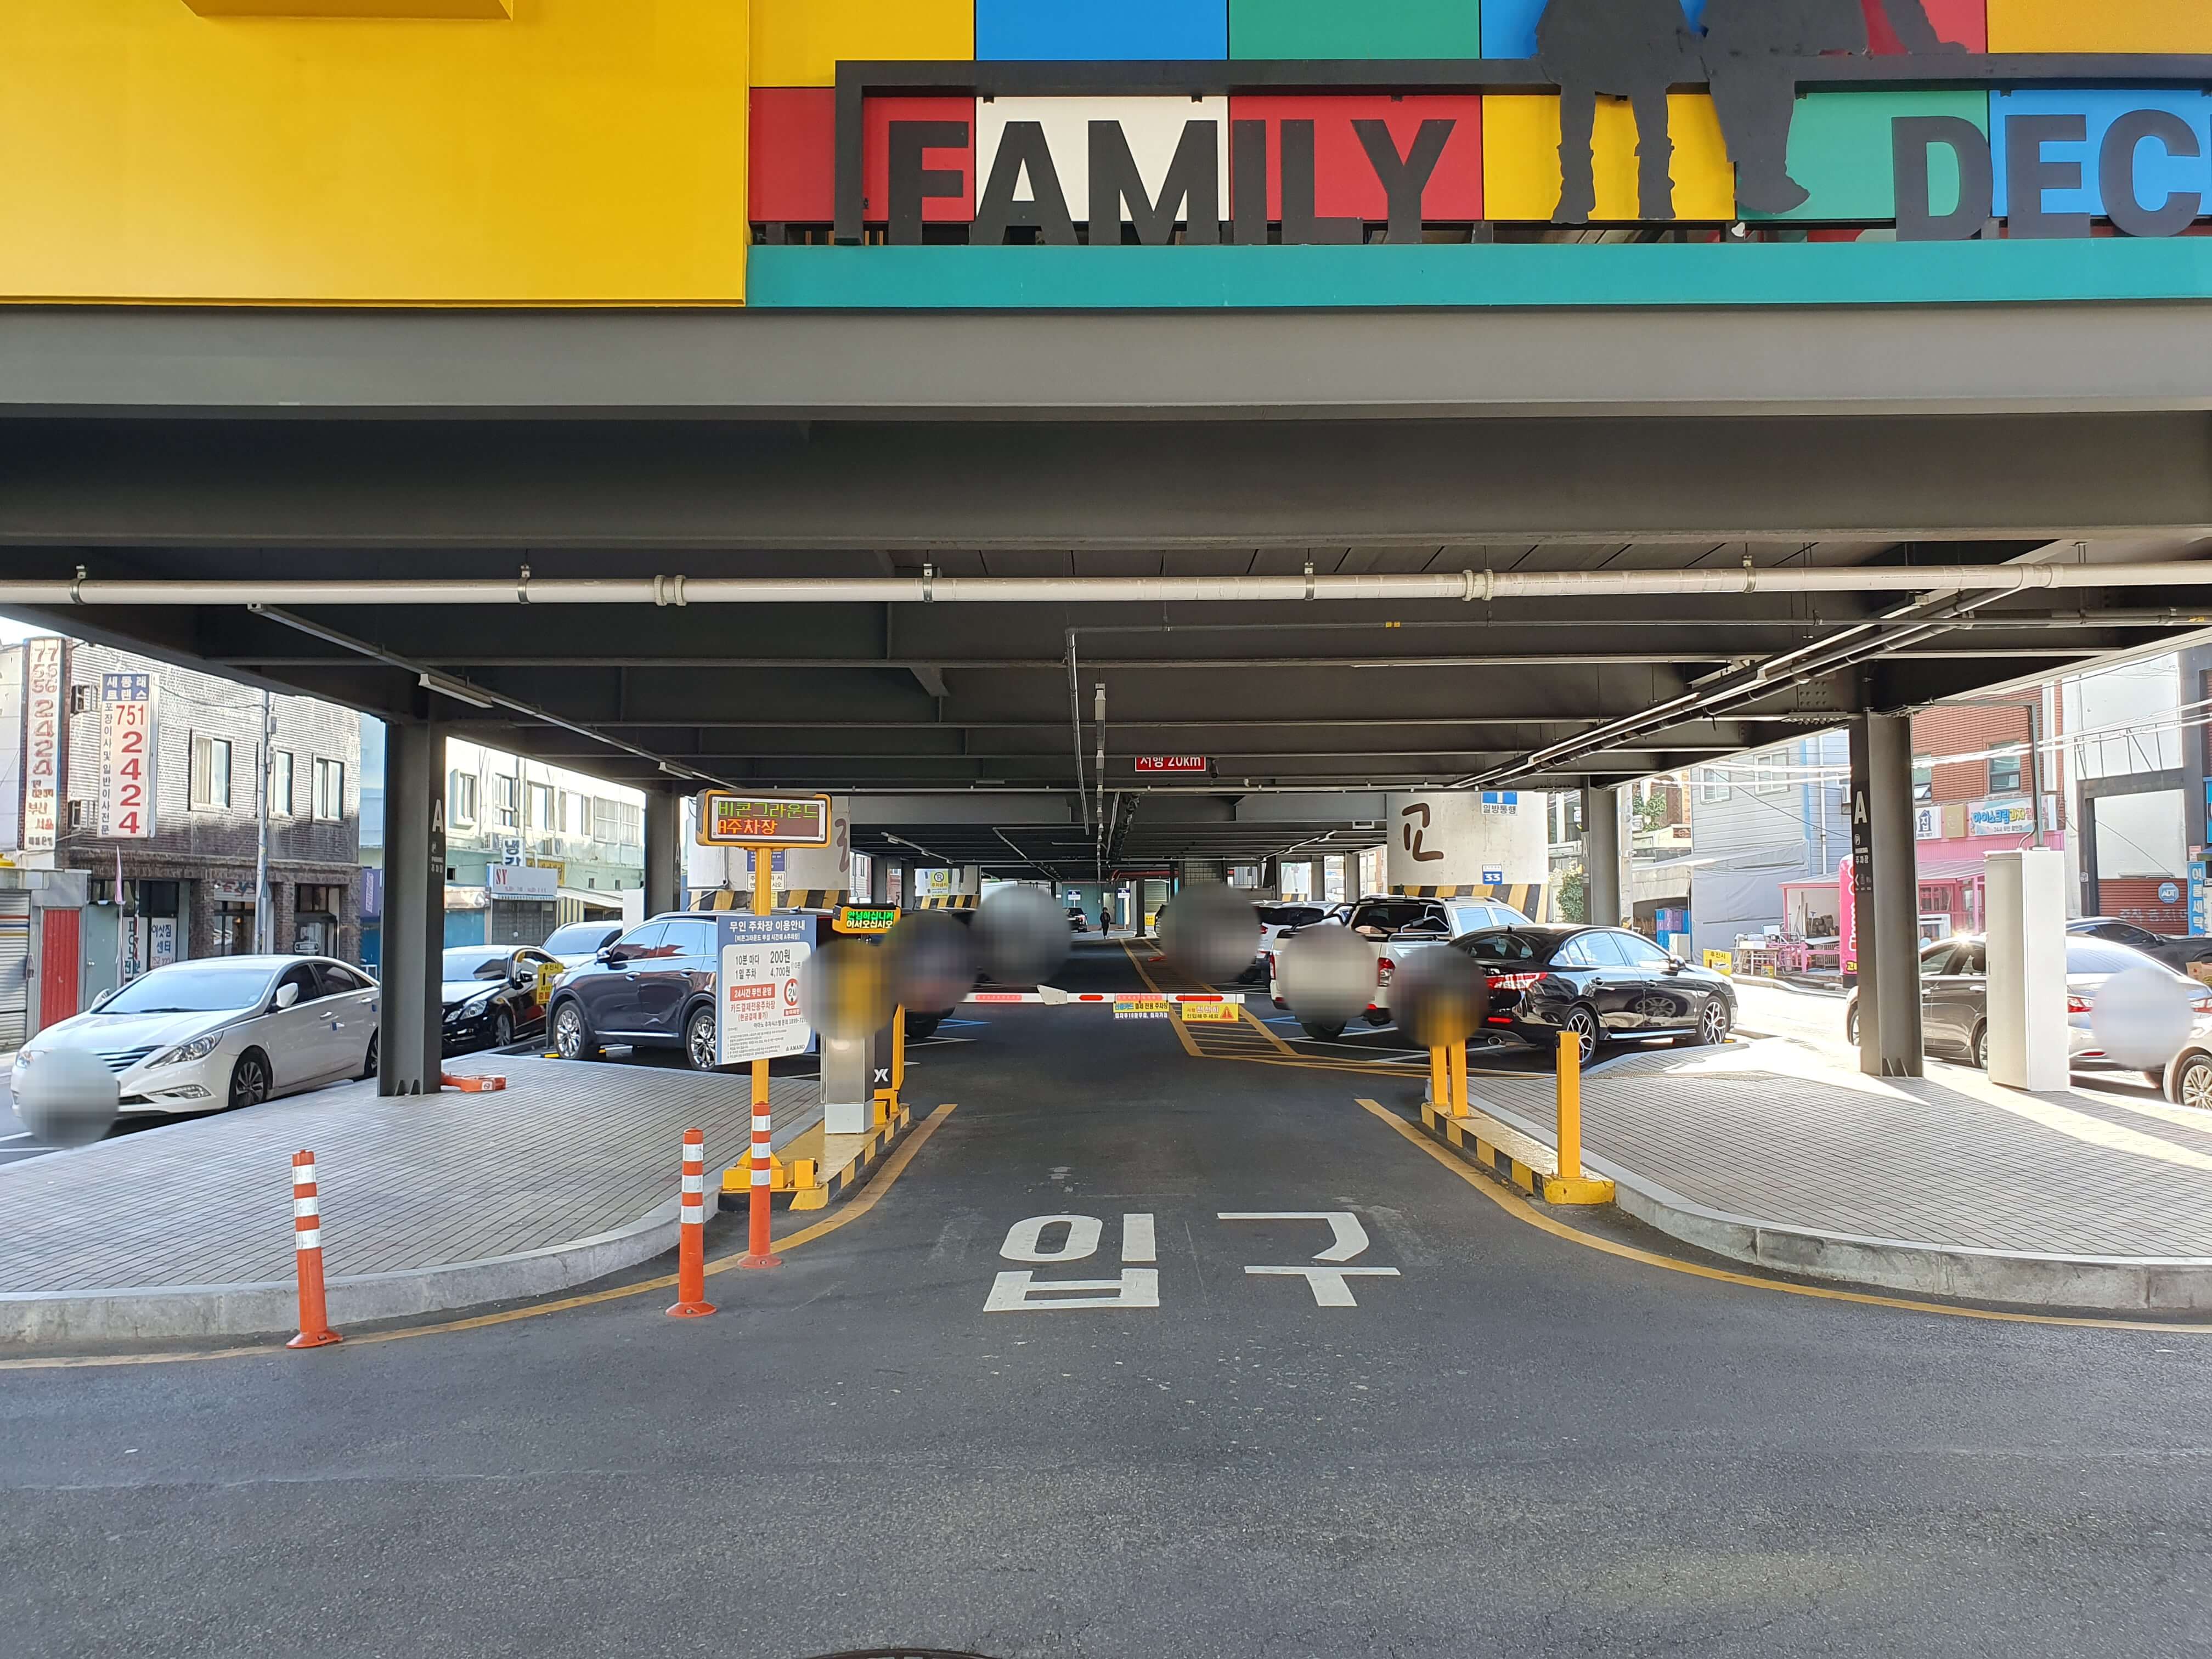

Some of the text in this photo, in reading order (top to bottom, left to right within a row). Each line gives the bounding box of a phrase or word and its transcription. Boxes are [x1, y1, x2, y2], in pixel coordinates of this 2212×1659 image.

[888, 109, 2212, 246] FAMILY DEC
[116, 704, 144, 725] 751
[1141, 757, 1200, 768] 서행 20km
[118, 731, 143, 834] 2424
[718, 802, 818, 819] 비콘그라운드
[1483, 805, 1516, 814] 일방통행
[1854, 791, 1867, 825] A
[432, 799, 444, 833] A
[718, 820, 778, 834] A주차장
[496, 869, 507, 885] SY
[1485, 873, 1501, 882] 33
[151, 924, 172, 938] 이삿짐
[729, 919, 805, 933] 무인 주차장 이용안내
[157, 940, 171, 953] 센터
[735, 949, 791, 966] 10분 마다 200원
[735, 966, 791, 980] 1일 주차 4,700원
[734, 987, 772, 998] 24시간 무인 운영
[730, 1001, 776, 1013] 카드결제전용주차장
[738, 1014, 757, 1022] (현금결제
[983, 1211, 1401, 1312] 입구
